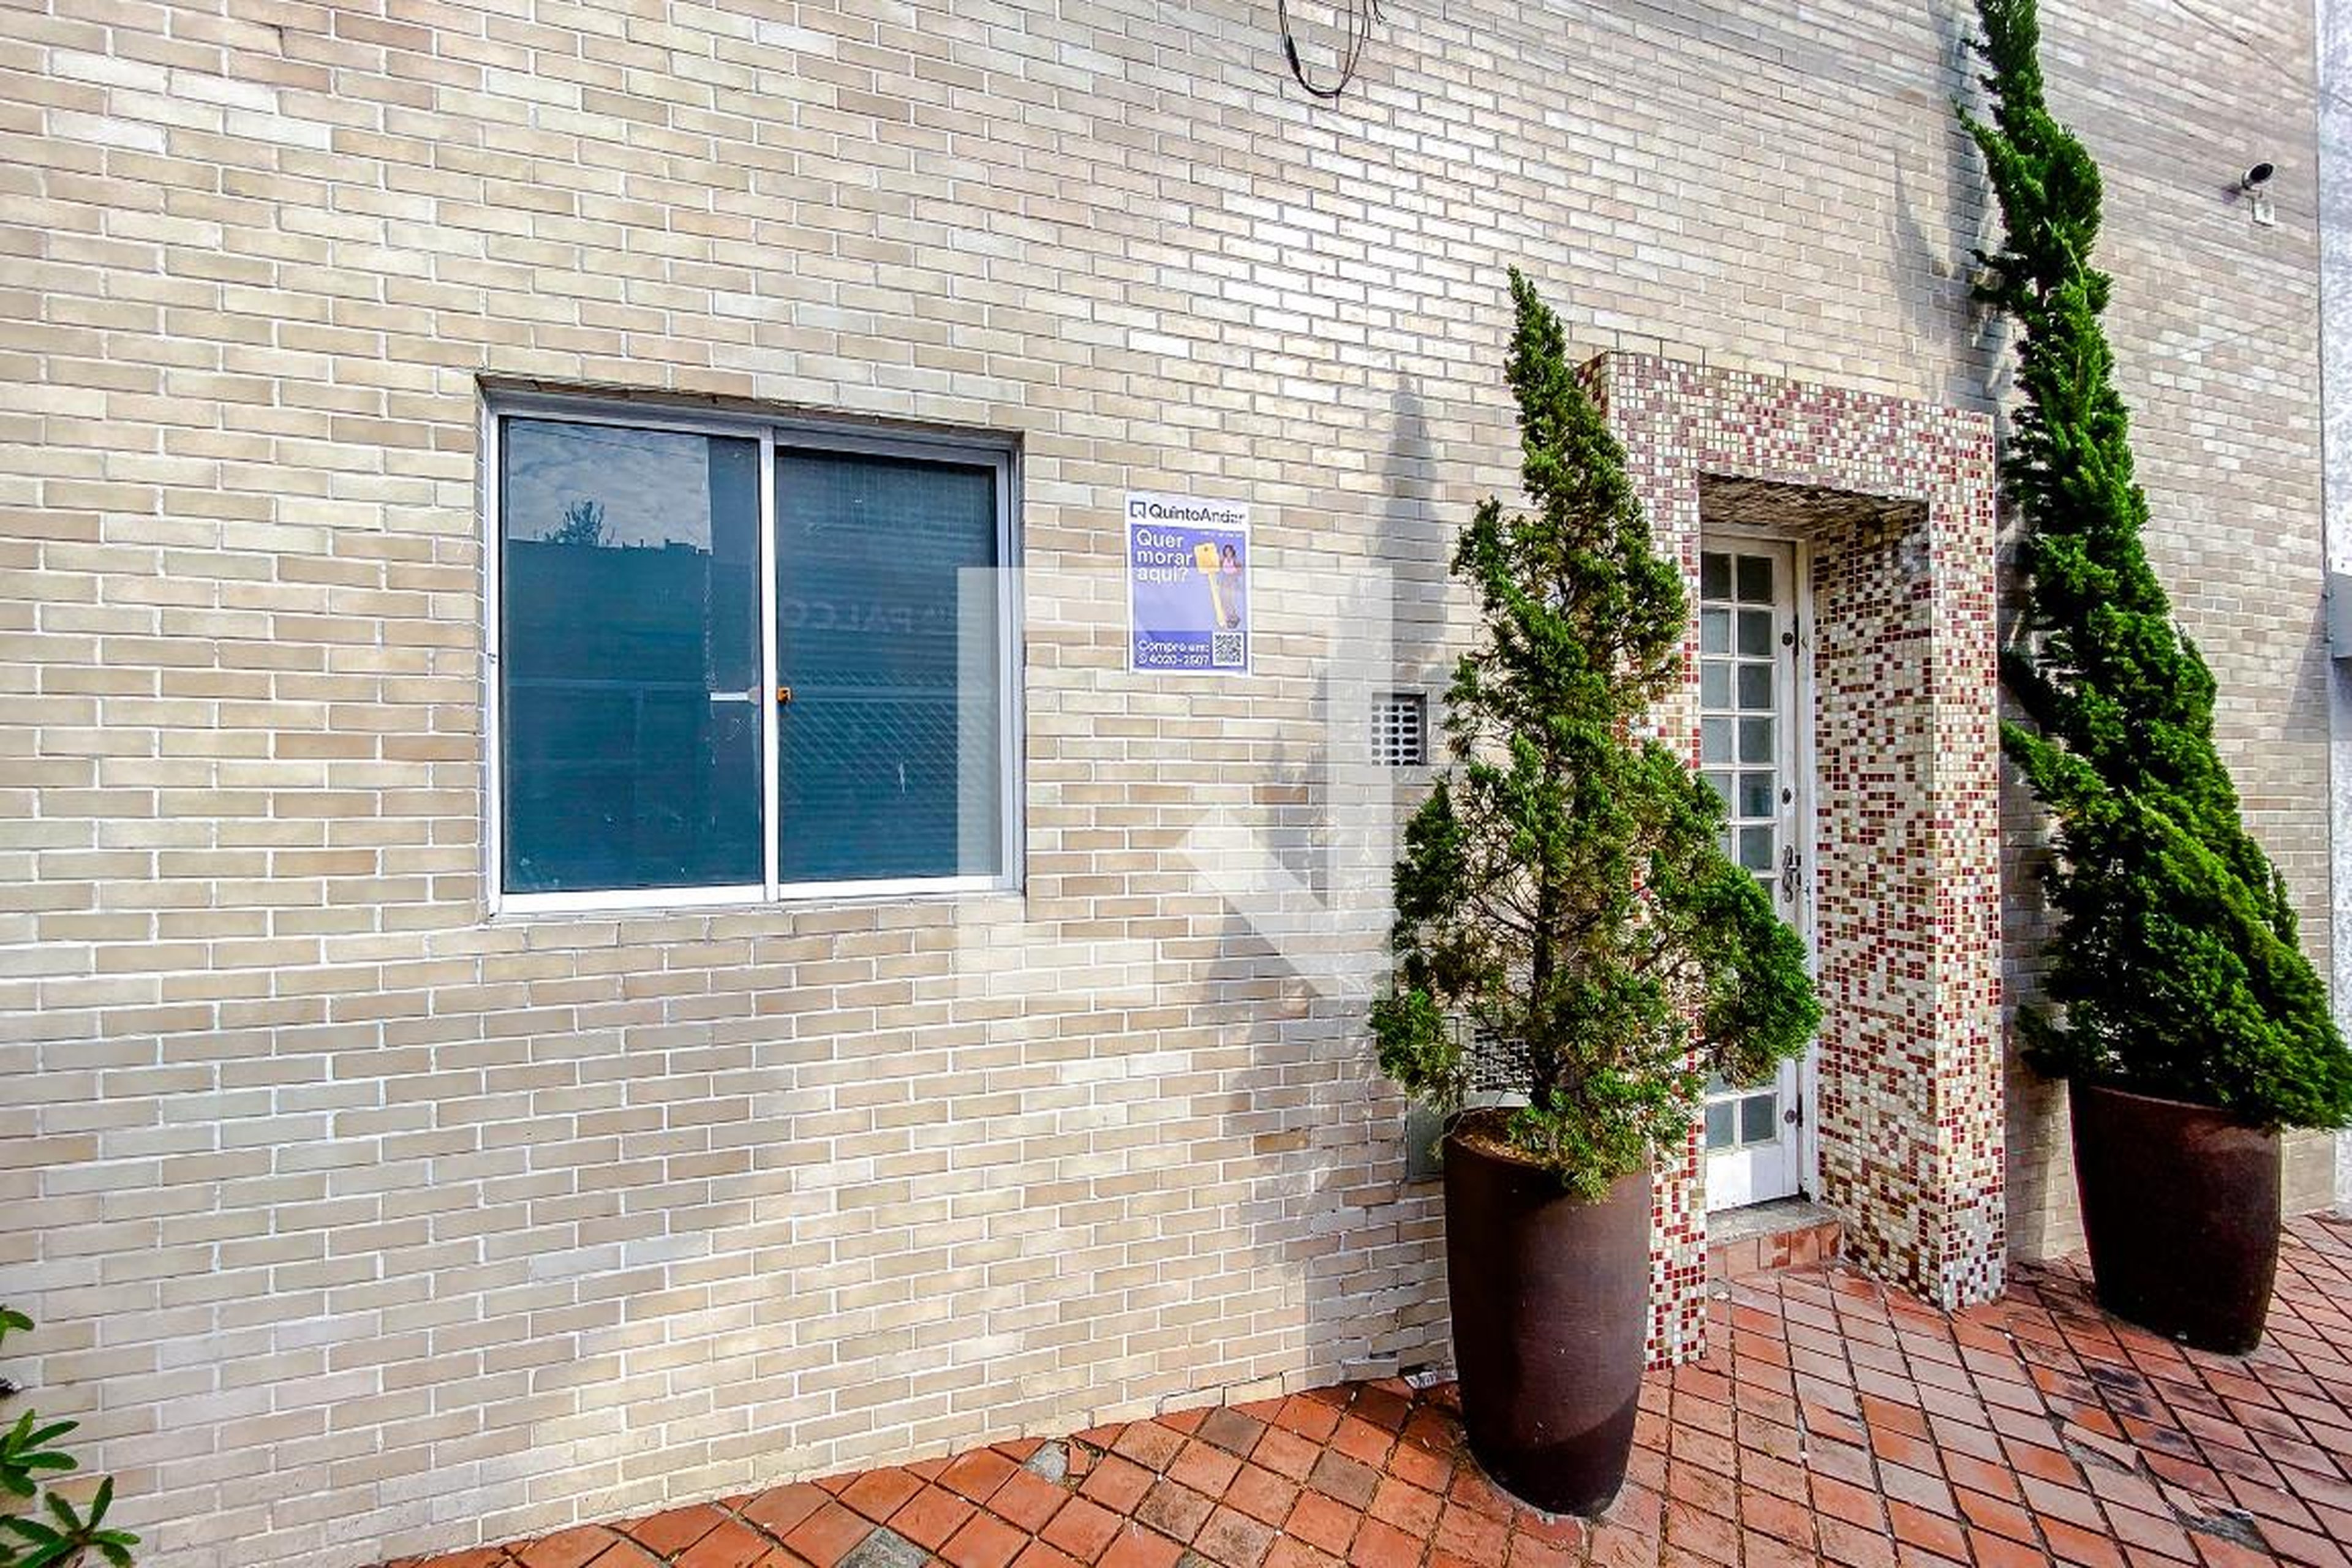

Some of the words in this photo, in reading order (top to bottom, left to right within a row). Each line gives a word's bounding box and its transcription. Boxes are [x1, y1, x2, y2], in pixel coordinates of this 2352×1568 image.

[1148, 503, 1245, 524] QuintoAndar
[1137, 529, 1185, 548] Quer
[1137, 550, 1193, 566] morar
[1137, 565, 1189, 584] aqui?
